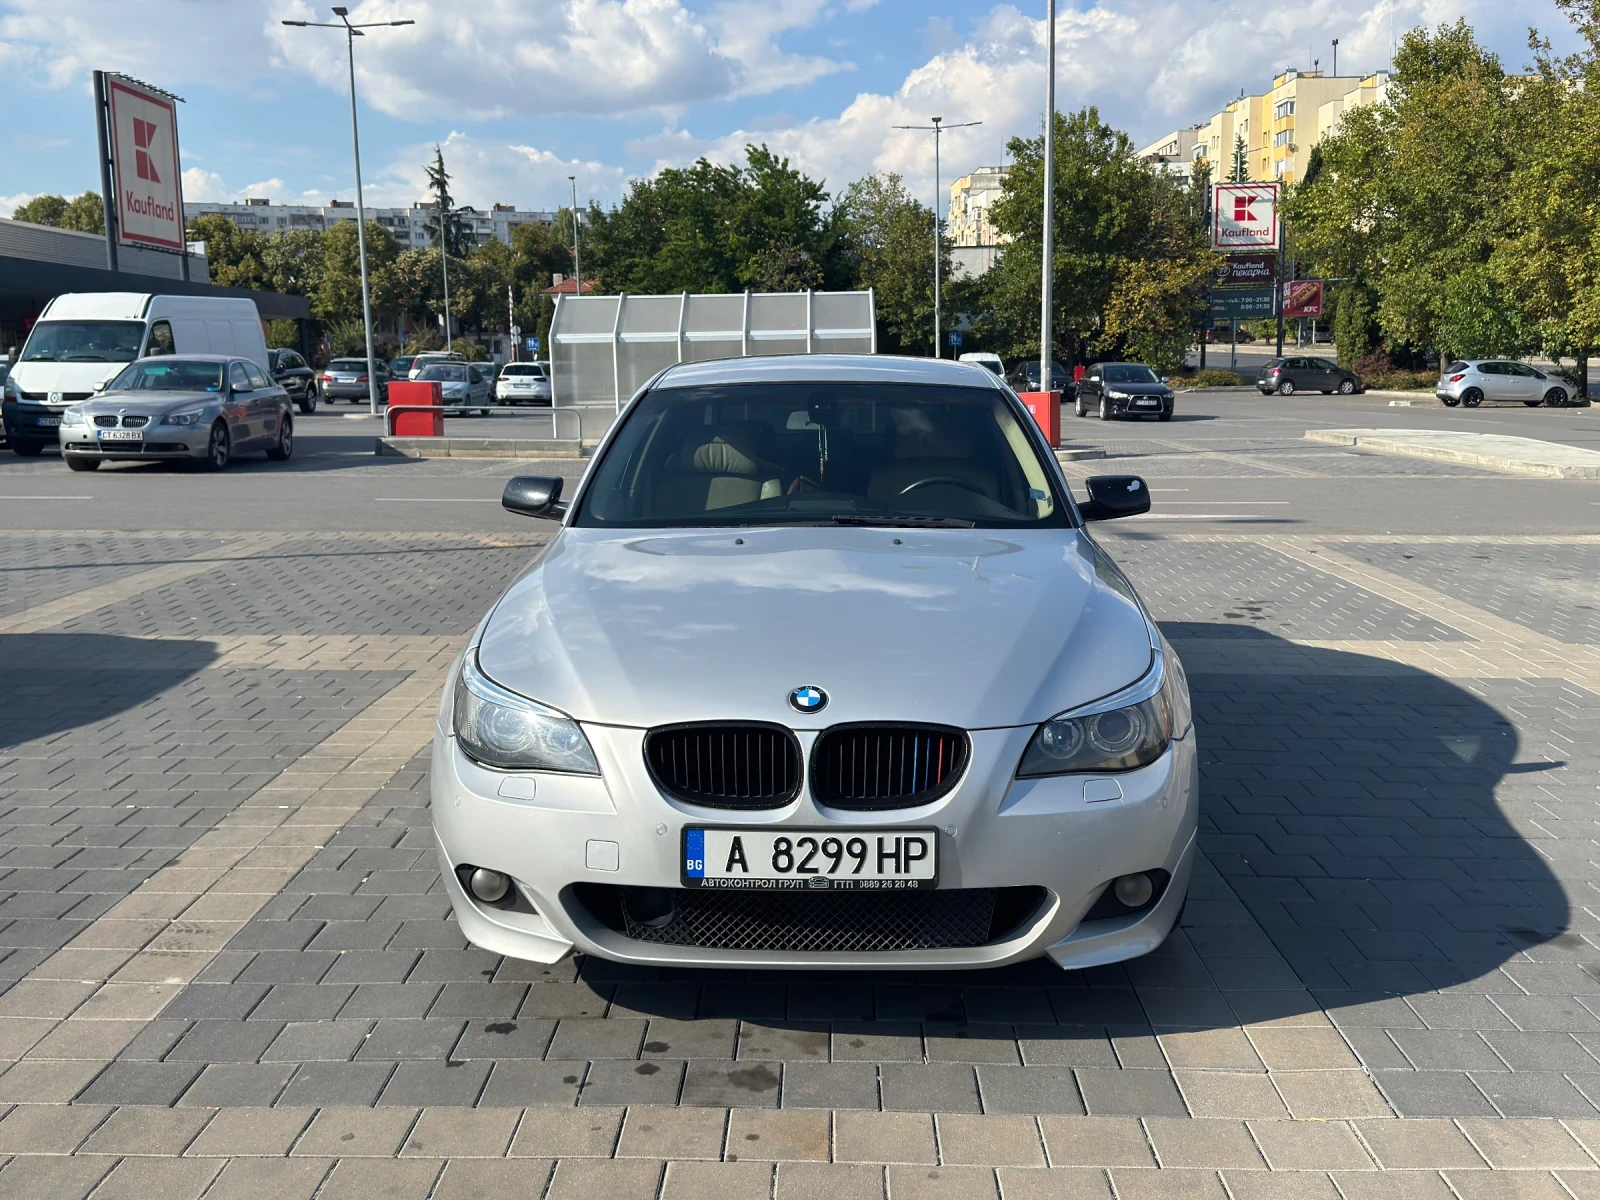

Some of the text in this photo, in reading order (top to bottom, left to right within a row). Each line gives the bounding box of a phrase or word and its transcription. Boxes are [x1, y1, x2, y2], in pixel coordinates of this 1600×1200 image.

[126, 190, 174, 222] Kaufland
[1221, 227, 1269, 237] Kaufland
[1232, 269, 1270, 277] пекарна
[102, 431, 111, 439] CT
[725, 835, 929, 874] A 8299 HP
[686, 859, 703, 870] BG
[701, 879, 919, 889] АВТОКОНТРОЛ ГРУП ГТП 0889 26 20 48
